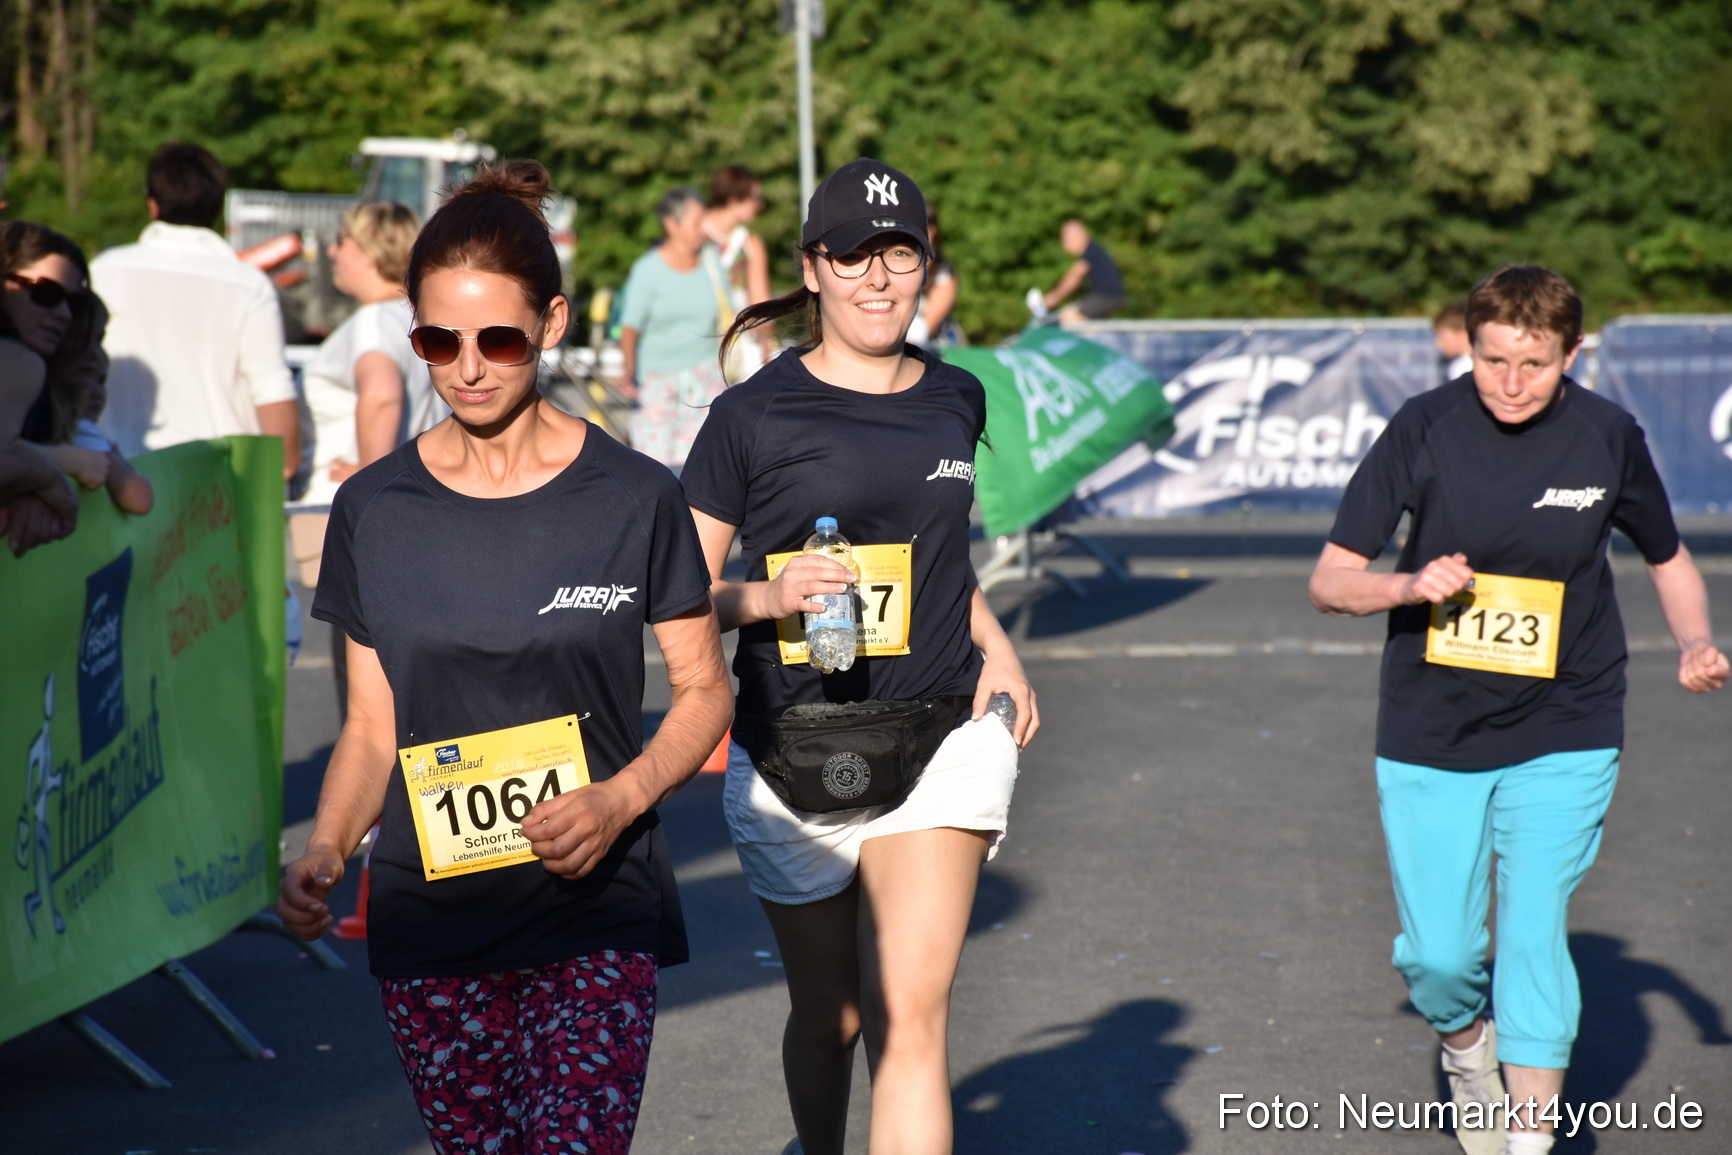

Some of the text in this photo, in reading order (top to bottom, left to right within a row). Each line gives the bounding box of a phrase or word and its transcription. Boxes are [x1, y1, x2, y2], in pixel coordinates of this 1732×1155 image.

[864, 173, 899, 206] NY
[1195, 401, 1388, 457] Fisch
[926, 459, 971, 480] JURA
[1222, 460, 1358, 488] AUTOM
[1533, 488, 1586, 508] JURA
[538, 586, 611, 614] JURA
[857, 627, 877, 635] ena
[1446, 606, 1540, 646] 1123
[857, 637, 877, 645] markt
[1445, 639, 1538, 658] Wittmann Elisabeth
[60, 676, 164, 868] firmenlauf
[428, 755, 483, 776] firmenlauf
[493, 758, 525, 774] 2018
[435, 768, 562, 836] 1064
[464, 828, 523, 849] Schorr R
[453, 841, 531, 862] Lebenshilfe Neum
